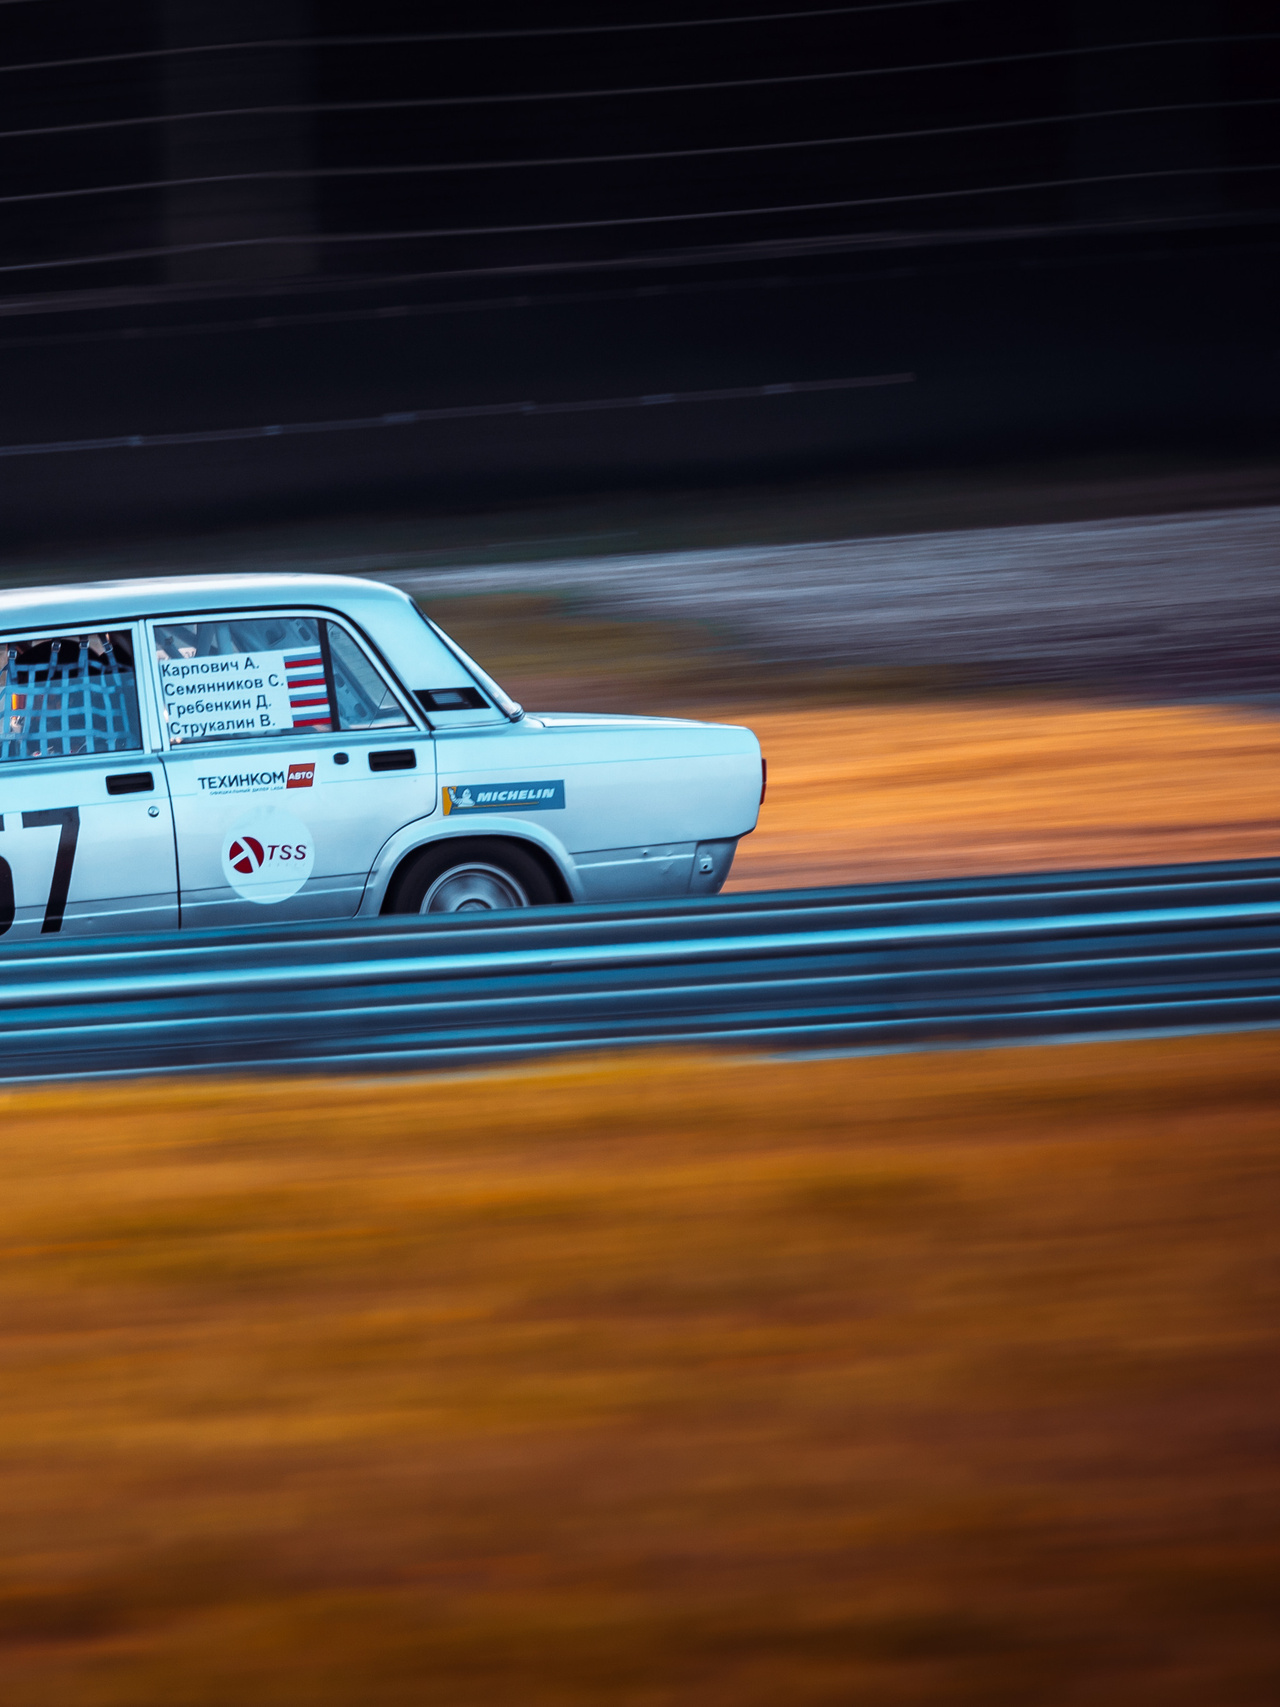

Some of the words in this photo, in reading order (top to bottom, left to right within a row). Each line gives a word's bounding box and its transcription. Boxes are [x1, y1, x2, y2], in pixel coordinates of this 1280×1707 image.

[161, 662, 239, 678] Карпович
[245, 657, 260, 670] А.
[164, 679, 264, 696] Семянников
[268, 674, 284, 687] С.
[167, 699, 251, 718] Гребенкин
[256, 694, 272, 710] Д.
[170, 717, 255, 736] Струкалин
[260, 714, 276, 727] В.
[197, 771, 285, 790] ТЕХИНКОМ
[288, 771, 314, 781] АВТО
[476, 788, 555, 803] MICHELIN
[267, 844, 307, 861] TSS
